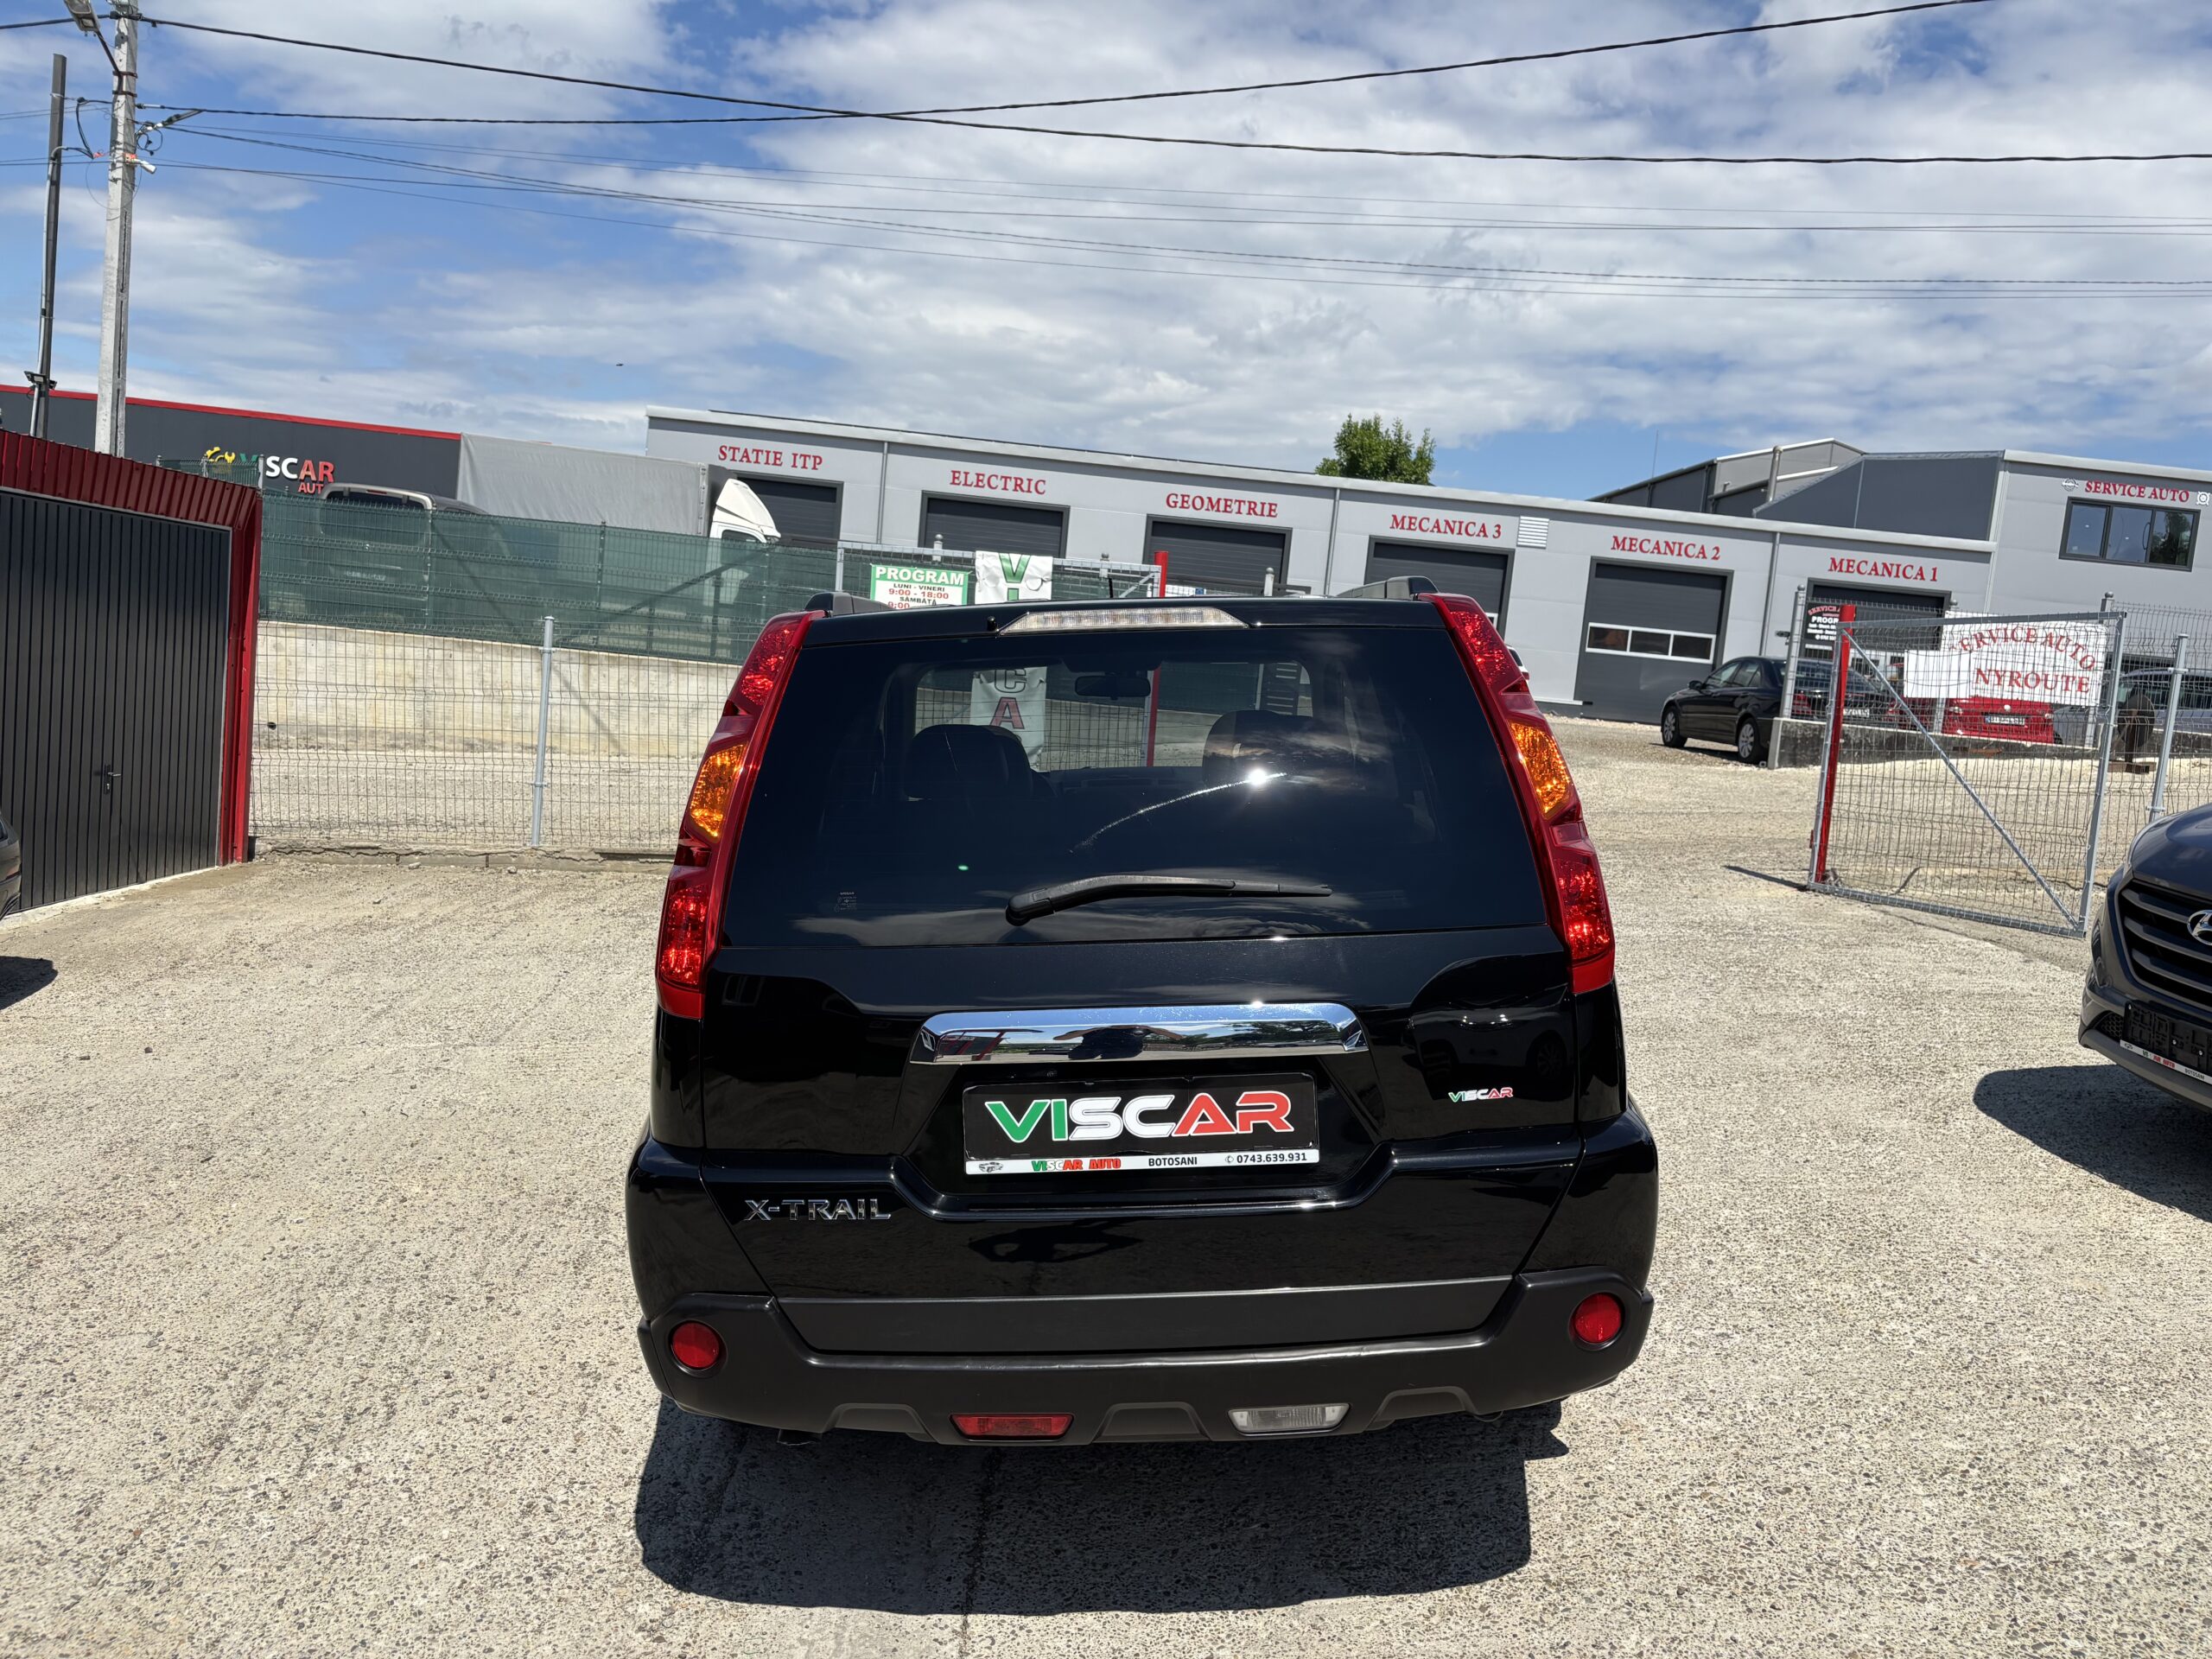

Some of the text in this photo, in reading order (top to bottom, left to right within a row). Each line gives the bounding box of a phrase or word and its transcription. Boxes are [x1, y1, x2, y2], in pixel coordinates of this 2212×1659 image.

[239, 453, 335, 483] SCAR
[718, 445, 823, 470] STATIE ITP
[298, 482, 324, 495] AUT
[950, 470, 1046, 495] ELECTRIC
[2084, 480, 2190, 503] SERVICE AUTO
[1165, 493, 1279, 518] GEOMETRIE
[1389, 514, 1503, 539] MECANICA 3
[1611, 535, 1721, 561] MECANICA 2
[875, 566, 964, 586] PROGRAM
[1827, 556, 1938, 582] MECANICA 1
[888, 588, 911, 596] 9:00
[2040, 631, 2096, 671] AUTO
[1448, 1086, 1514, 1103] VISCAR
[984, 1090, 1295, 1143] VISCAR
[1031, 1153, 1307, 1172] VISCAR AUTO BOTOSANI 0743.639.931
[743, 1198, 892, 1221] X-TRAIL
